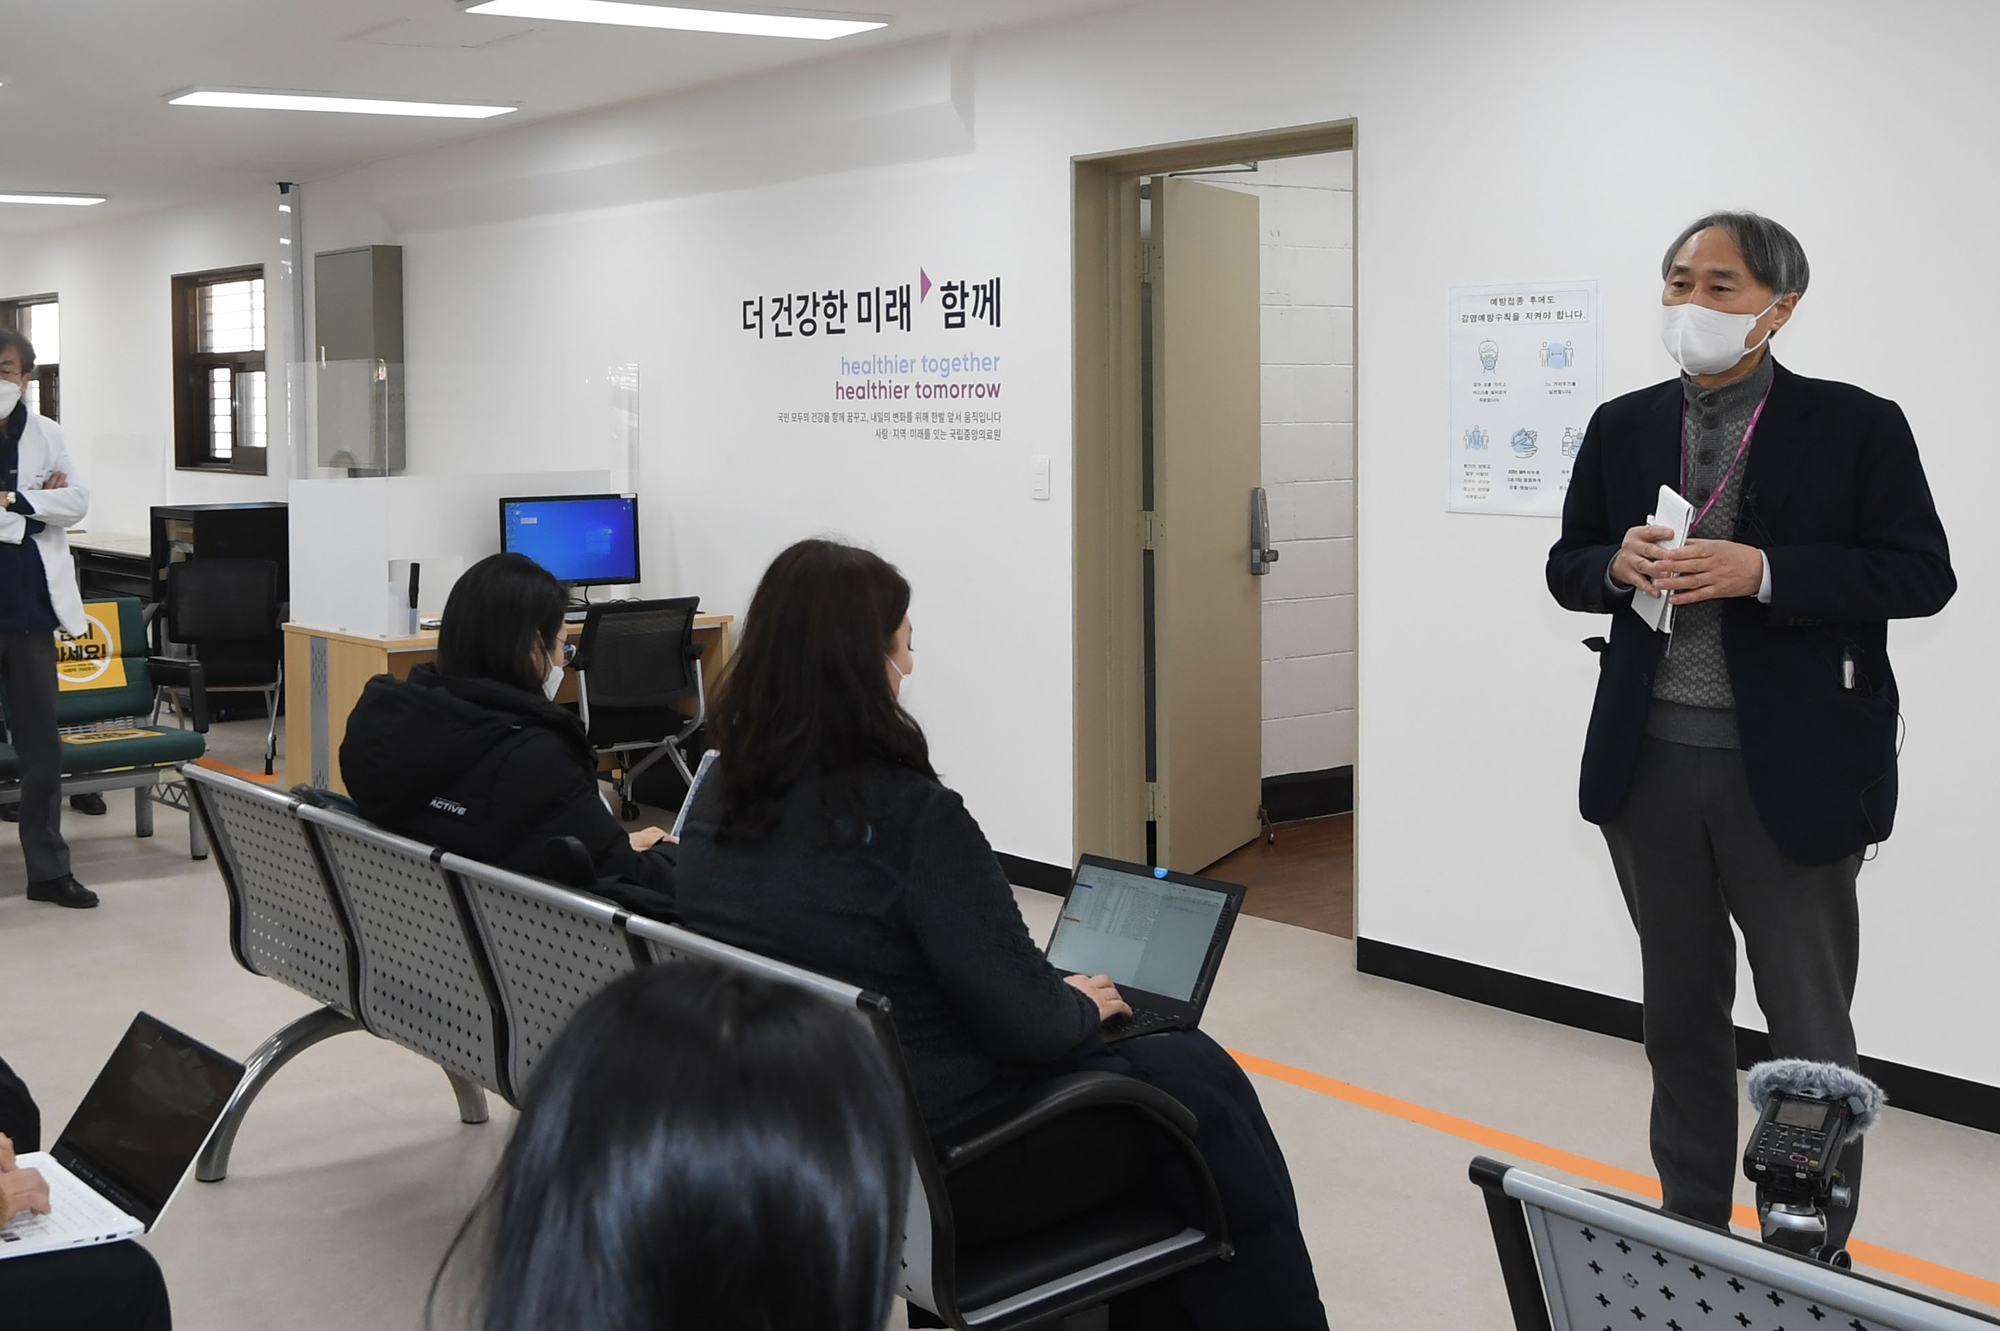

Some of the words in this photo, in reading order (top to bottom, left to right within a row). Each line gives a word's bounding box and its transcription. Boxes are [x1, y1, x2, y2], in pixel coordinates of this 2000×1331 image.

[742, 295, 764, 339] 더
[770, 289, 848, 338] 건강한
[857, 284, 911, 333] 미래
[940, 277, 1001, 329] 함께
[1490, 296, 1524, 307] 예방접종
[1529, 295, 1555, 305] 후에도
[1525, 311, 1551, 321] 지켜야
[841, 354, 916, 376] healthier
[922, 351, 1000, 378] together
[836, 379, 910, 400] healthier
[915, 381, 1001, 400] tomorrow
[778, 412, 790, 423] 국민
[791, 412, 809, 423] 모두의
[811, 412, 830, 423] 건강을
[832, 412, 845, 423] 함께
[870, 412, 891, 423] 내일의
[892, 411, 913, 423] 변화를
[915, 411, 929, 423] 위해
[931, 411, 945, 423] 한발
[947, 411, 962, 423] 앞서
[964, 411, 1001, 423] 움직입니다
[933, 428, 947, 440] 잇는
[949, 428, 1001, 441] 국립중앙의료원
[429, 799, 467, 815] ACTIVE
